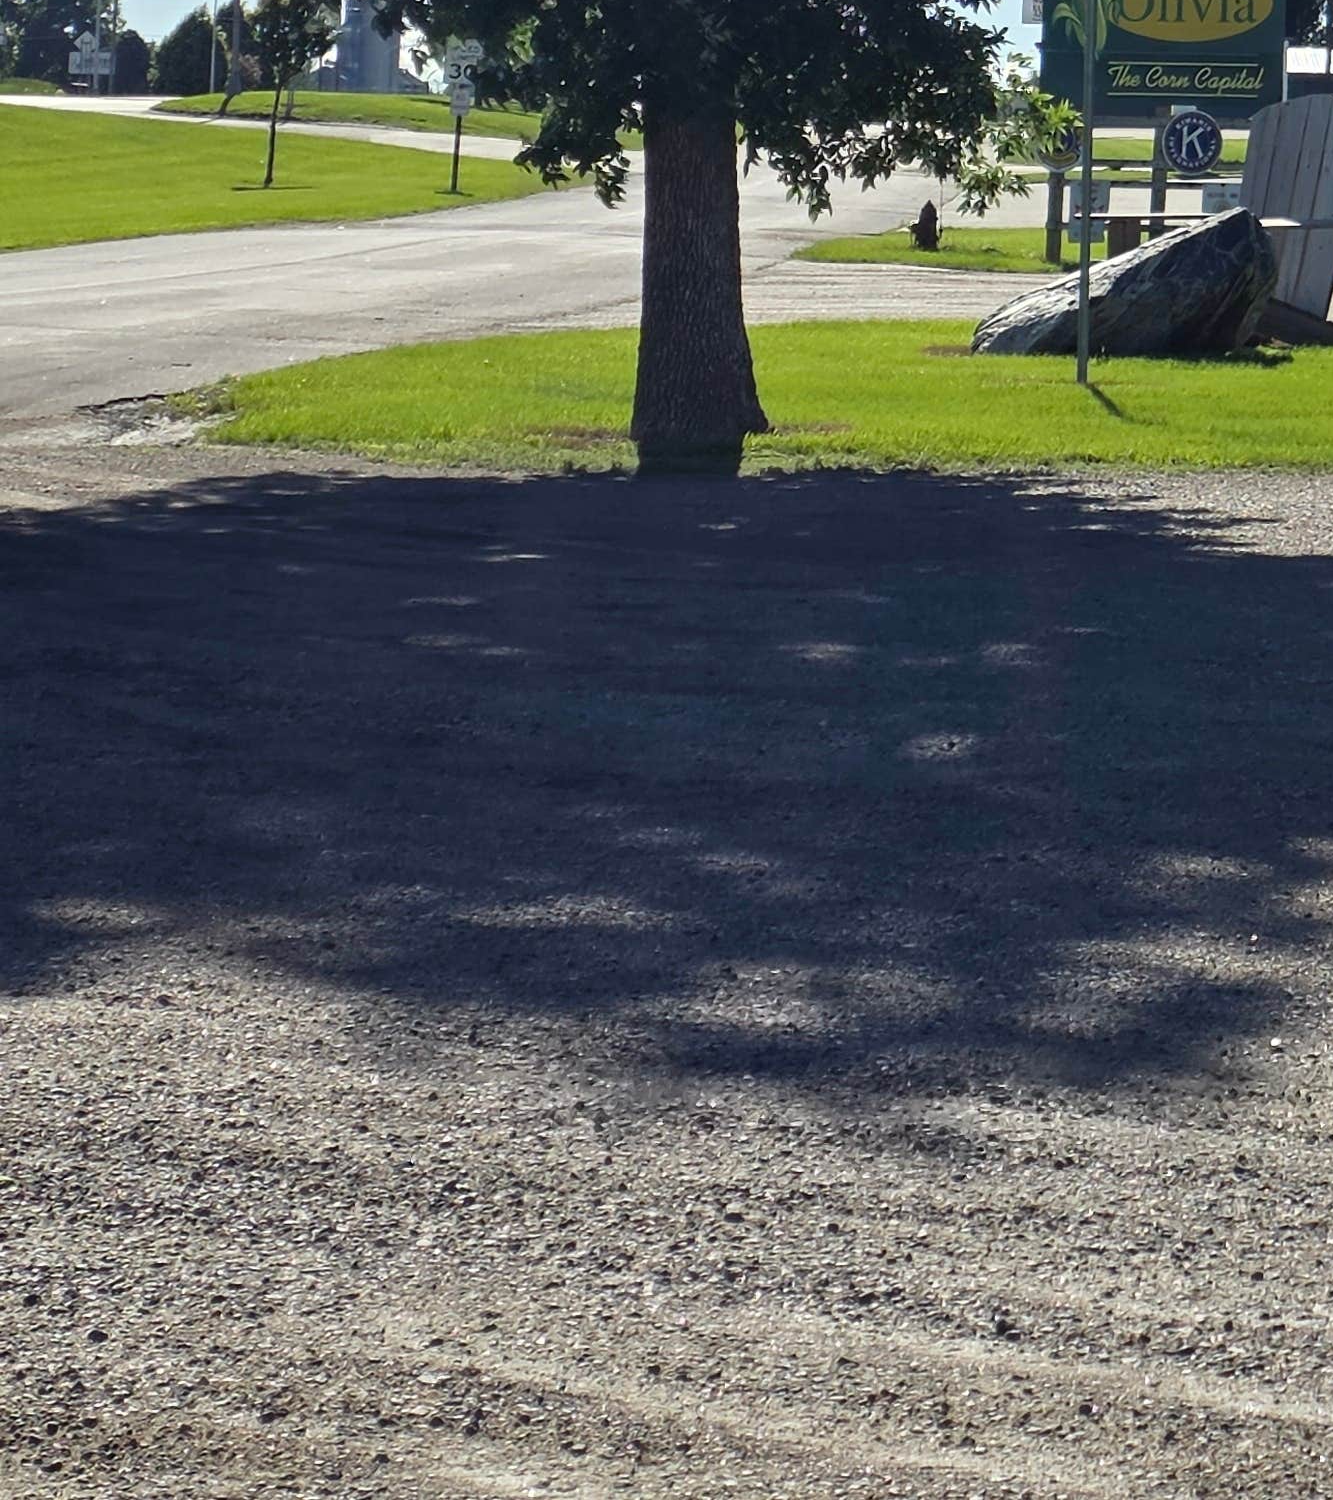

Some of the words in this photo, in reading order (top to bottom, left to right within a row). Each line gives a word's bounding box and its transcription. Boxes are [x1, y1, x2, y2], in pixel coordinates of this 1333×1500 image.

[1107, 64, 1141, 88] The
[1145, 66, 1191, 88] Corn
[1194, 67, 1264, 95] Capital
[1181, 125, 1205, 160] K
